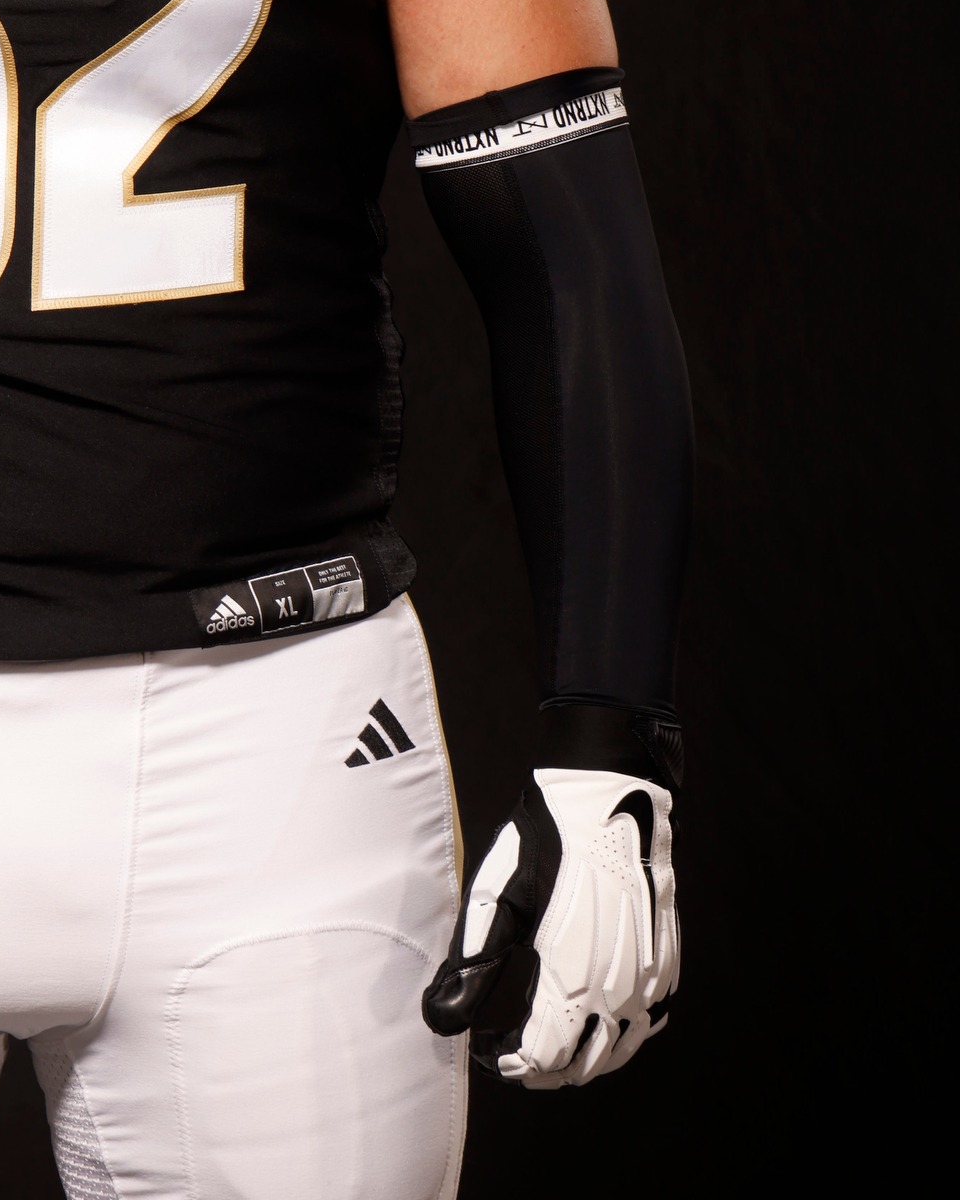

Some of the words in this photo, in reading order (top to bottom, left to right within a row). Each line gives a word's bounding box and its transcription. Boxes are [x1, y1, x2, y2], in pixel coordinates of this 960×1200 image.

[552, 92, 610, 128] NXTRND
[436, 127, 499, 157] NXTRND
[275, 596, 298, 620] XL
[206, 614, 255, 634] adidas
